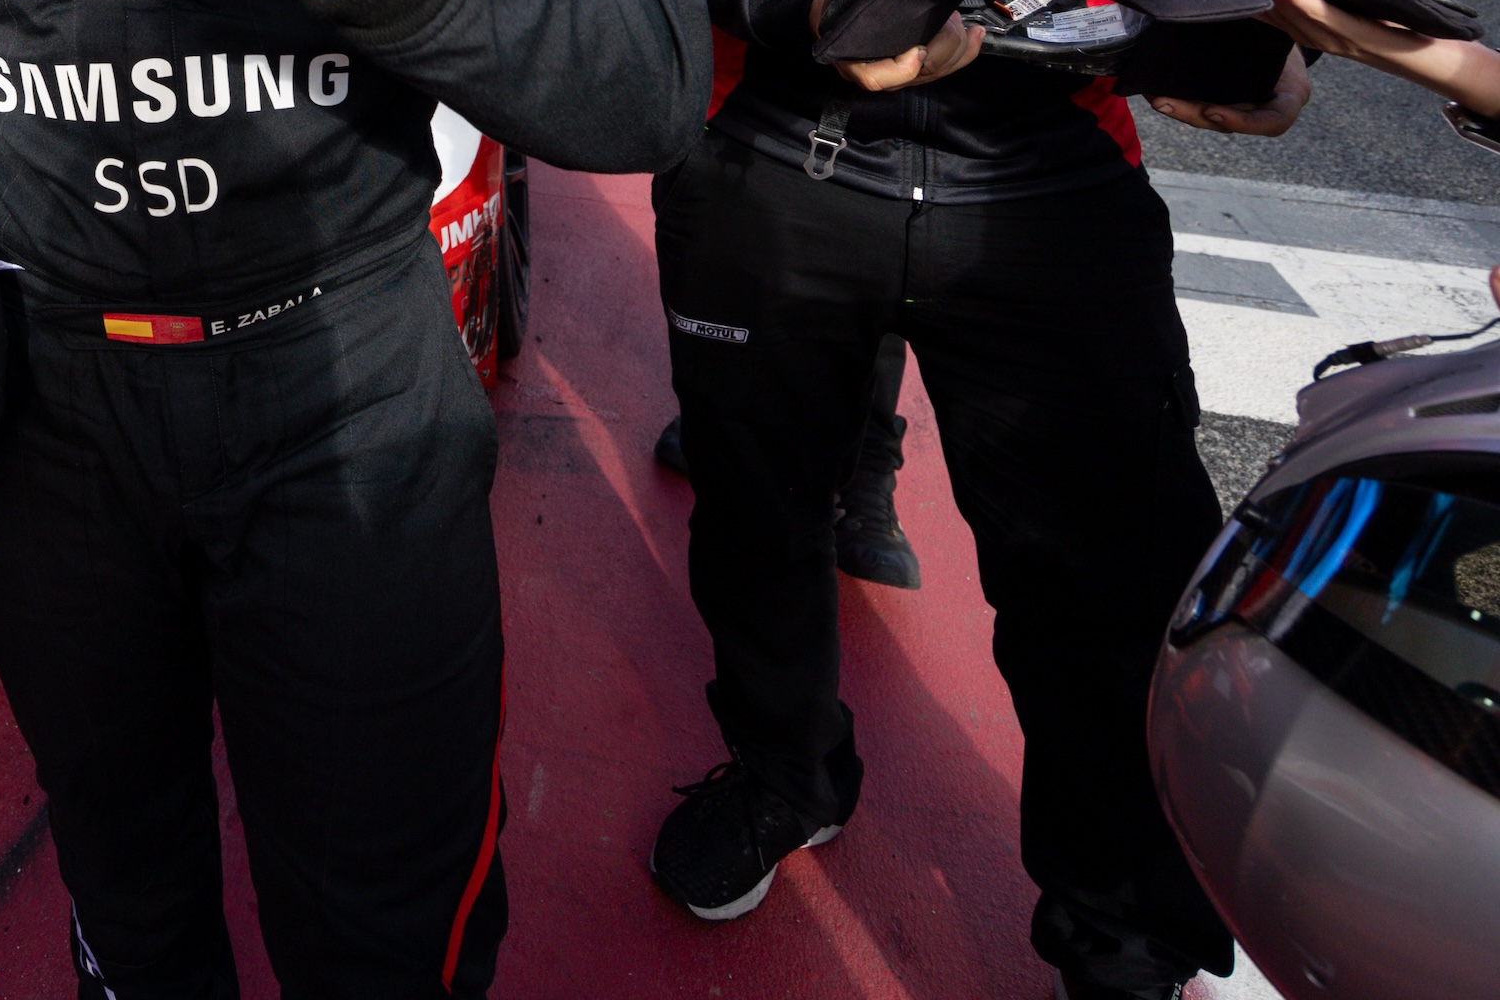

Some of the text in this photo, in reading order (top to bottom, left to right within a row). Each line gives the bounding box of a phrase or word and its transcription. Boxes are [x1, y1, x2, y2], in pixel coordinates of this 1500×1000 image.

[94, 157, 219, 218] SSD
[210, 320, 232, 336] E.
[695, 324, 737, 339] MOTUL
